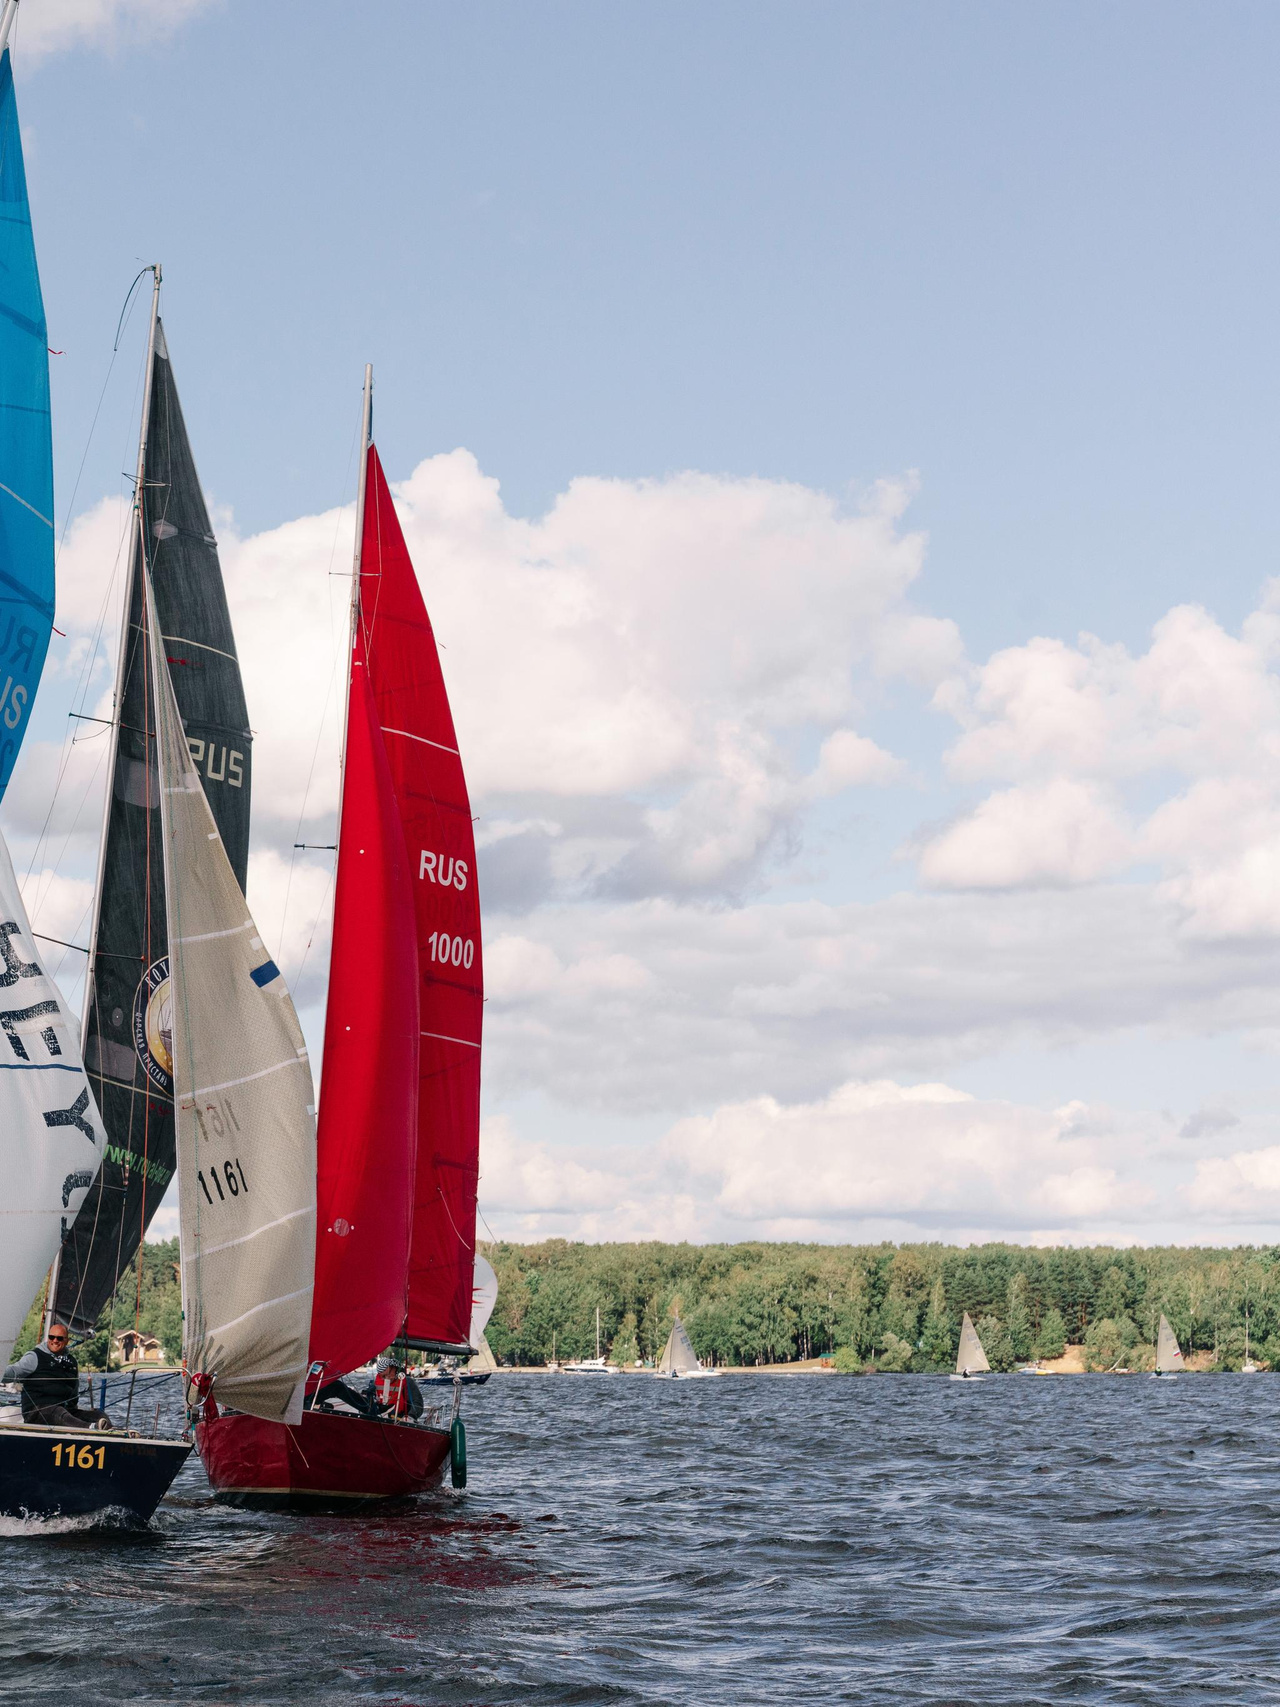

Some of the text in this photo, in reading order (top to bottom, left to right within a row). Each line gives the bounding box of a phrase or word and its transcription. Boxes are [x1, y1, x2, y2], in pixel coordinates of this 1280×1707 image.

[419, 850, 468, 890] RUS
[428, 931, 474, 969] 1000
[198, 1158, 248, 1204] 1161
[51, 1443, 106, 1470] 1161
